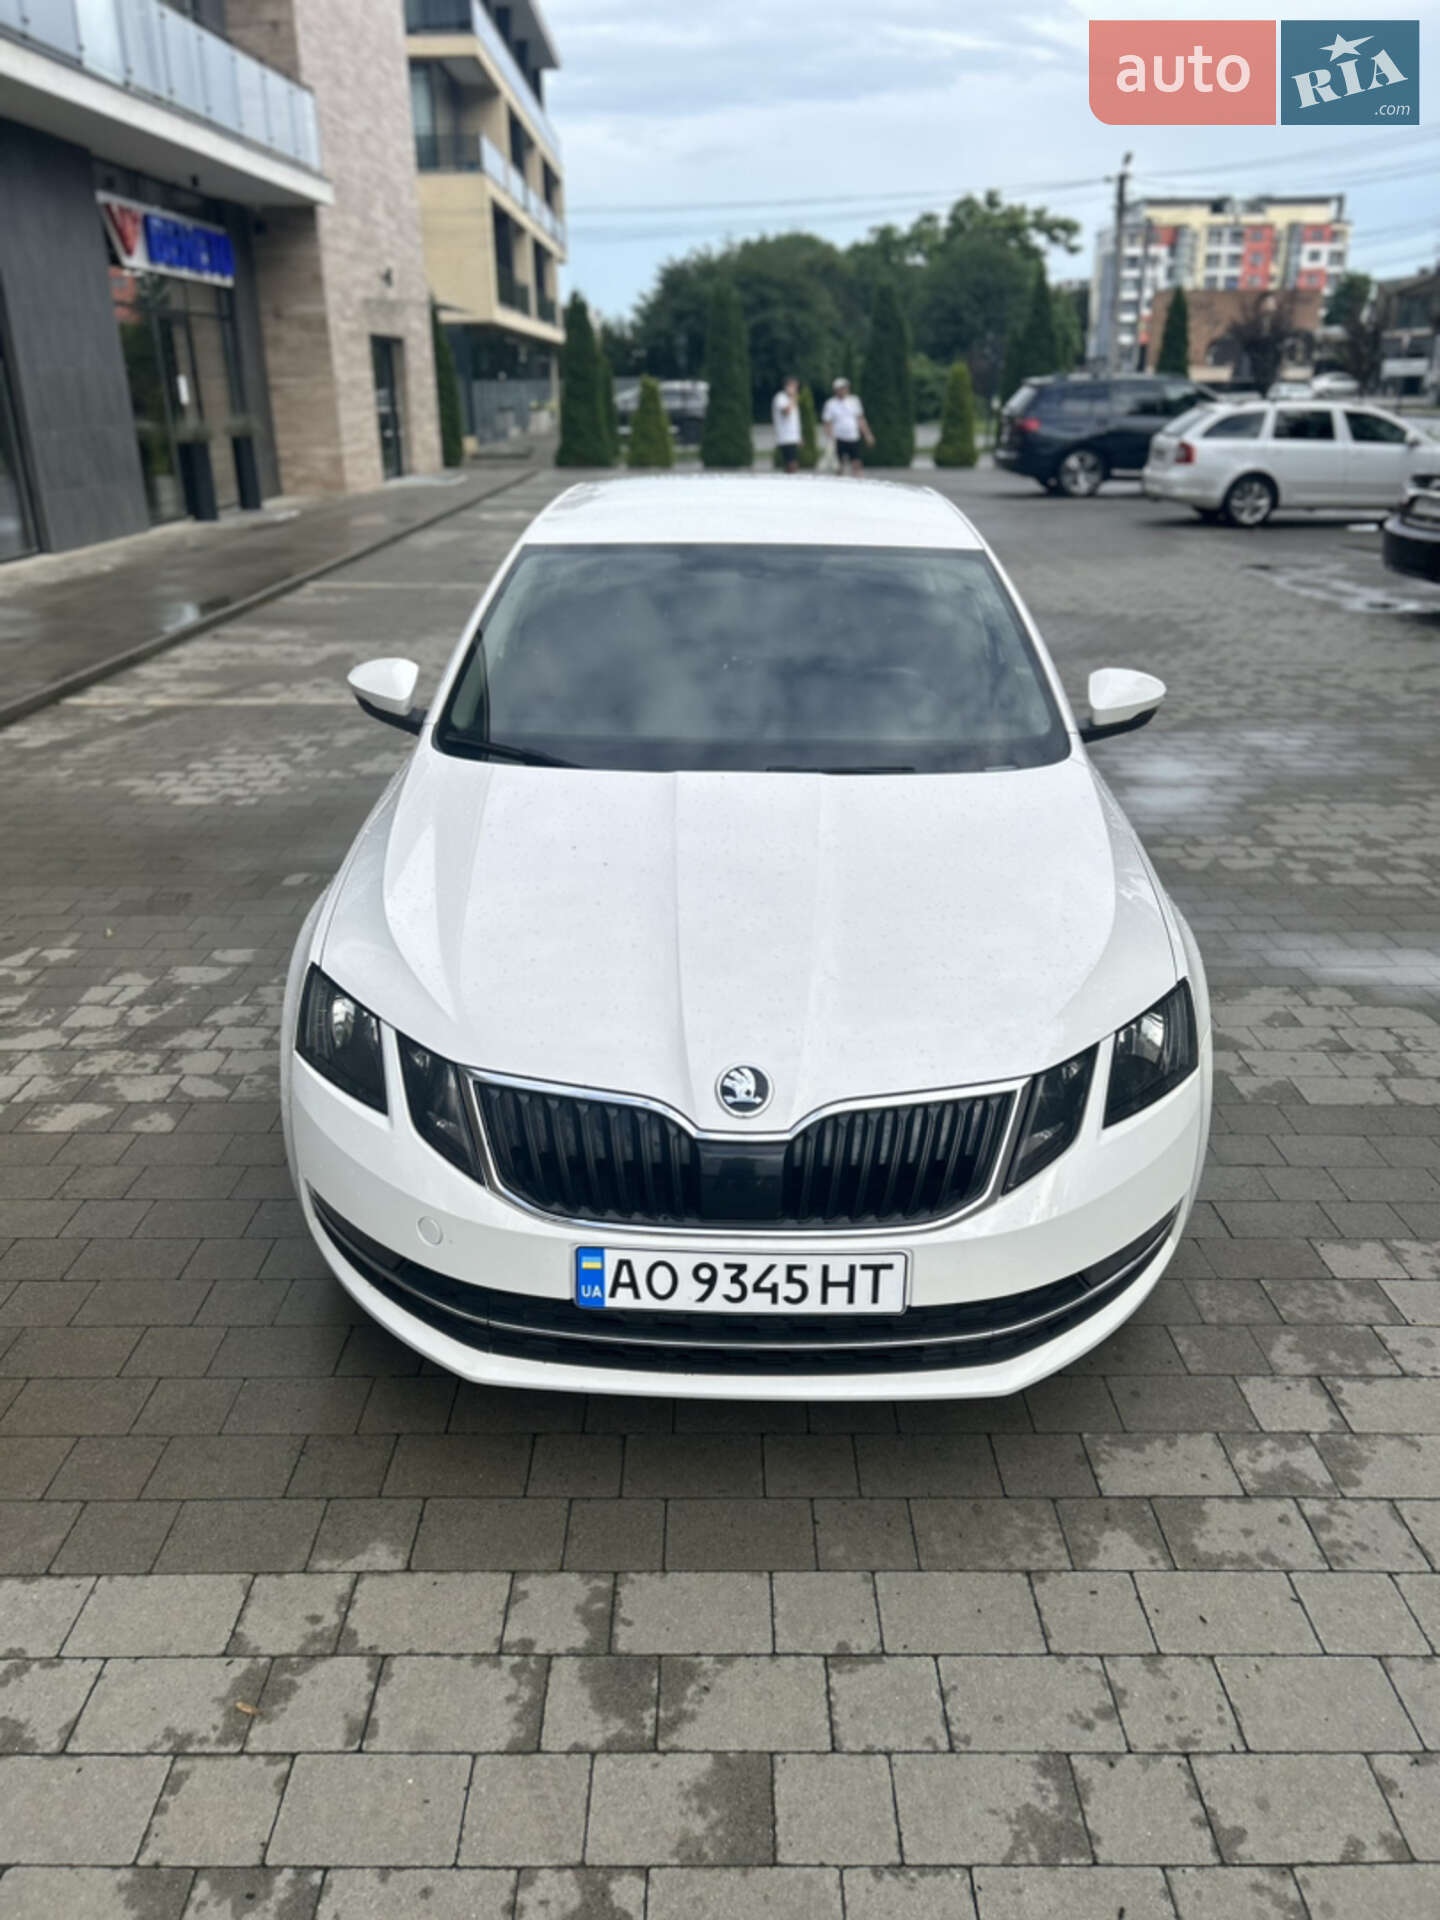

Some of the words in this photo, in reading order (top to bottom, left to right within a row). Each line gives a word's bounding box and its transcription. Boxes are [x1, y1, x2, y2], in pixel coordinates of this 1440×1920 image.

[581, 1284, 602, 1299] UA
[608, 1258, 679, 1301] AO
[692, 1261, 809, 1305] 9345
[820, 1263, 894, 1305] HT
